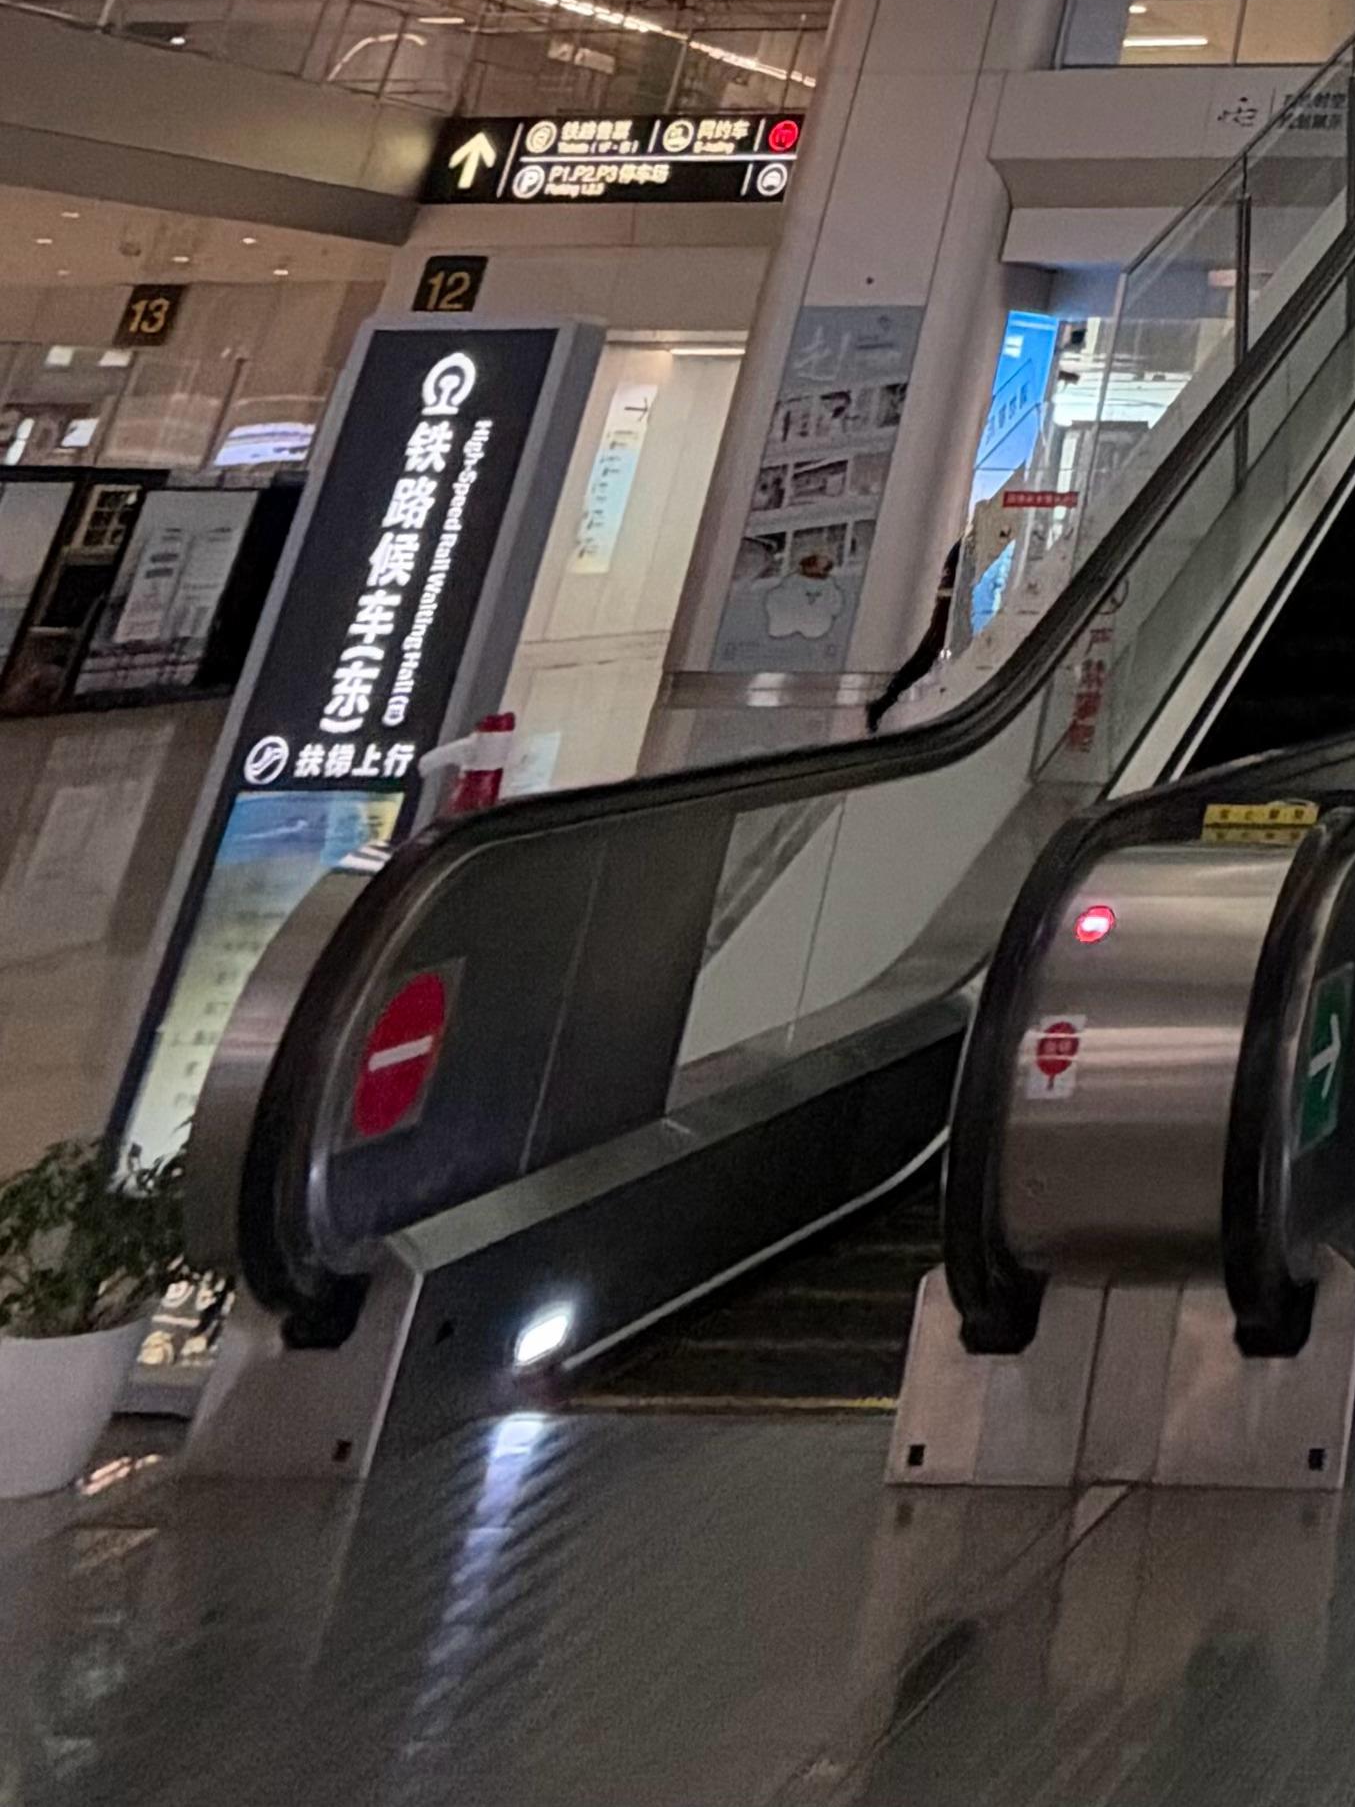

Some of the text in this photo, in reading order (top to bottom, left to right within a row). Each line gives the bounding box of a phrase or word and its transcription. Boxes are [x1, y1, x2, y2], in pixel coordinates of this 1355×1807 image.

[427, 269, 471, 311] 12
[128, 297, 170, 334] 13
[442, 419, 493, 532] High-Speed
[429, 533, 459, 572] Rail
[402, 572, 447, 650] Waiting
[391, 650, 421, 695] Hall
[293, 742, 416, 778] 扶梯上行
